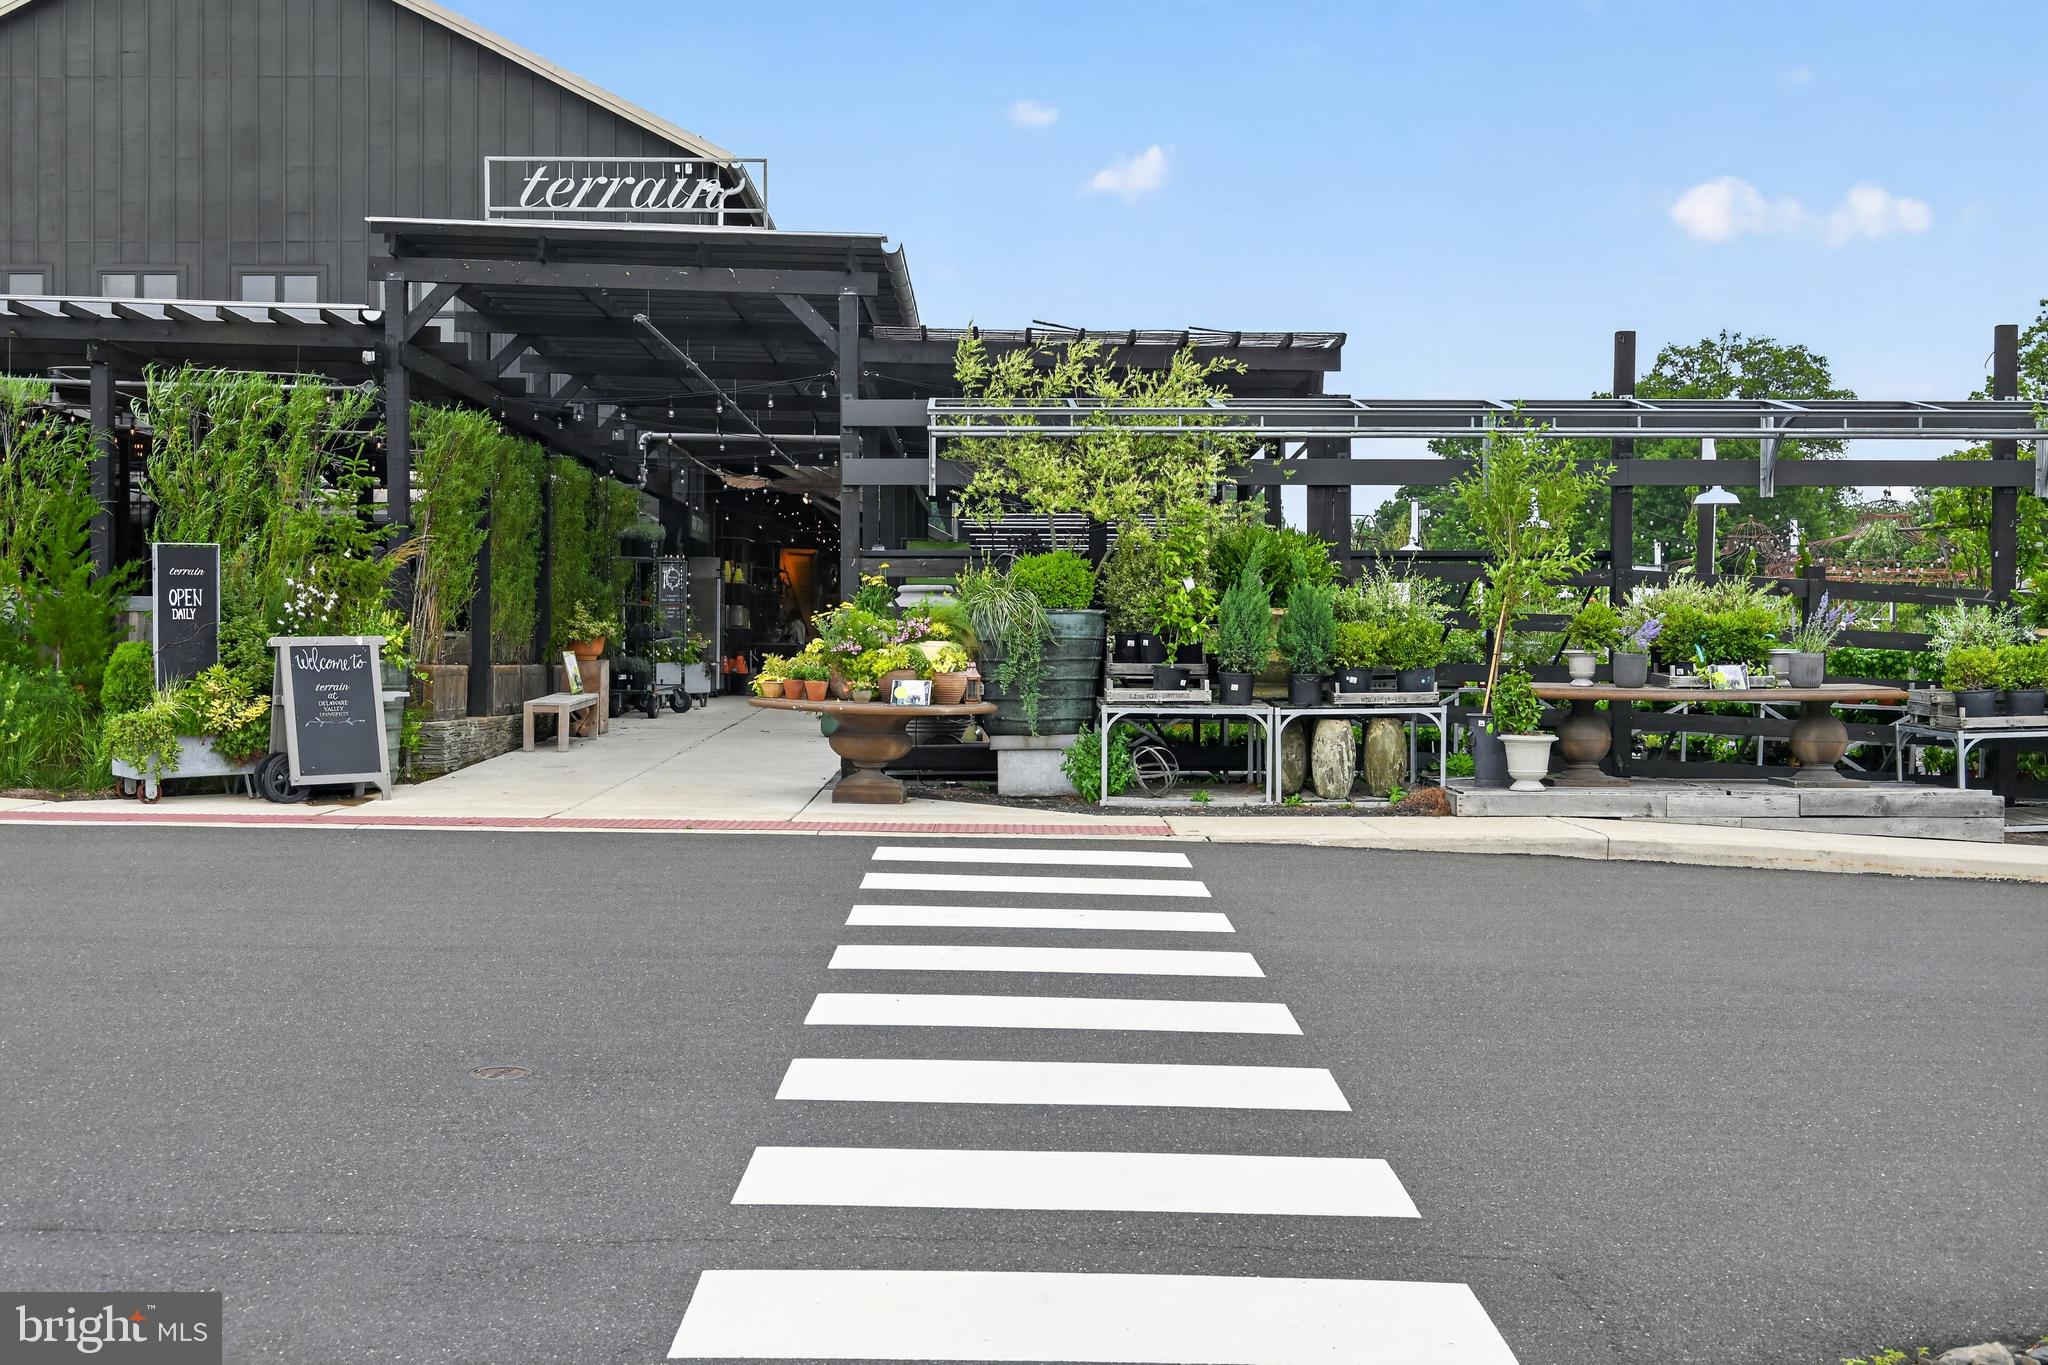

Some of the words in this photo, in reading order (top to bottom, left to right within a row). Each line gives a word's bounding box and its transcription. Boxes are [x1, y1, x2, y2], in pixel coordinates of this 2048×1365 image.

[518, 164, 735, 209] terrain
[169, 567, 205, 576] terrain
[168, 588, 203, 607] OPEN
[172, 607, 196, 620] DAILY
[294, 646, 350, 673] Welcome
[350, 653, 368, 669] to
[315, 682, 351, 691] terrain
[327, 692, 339, 700] at
